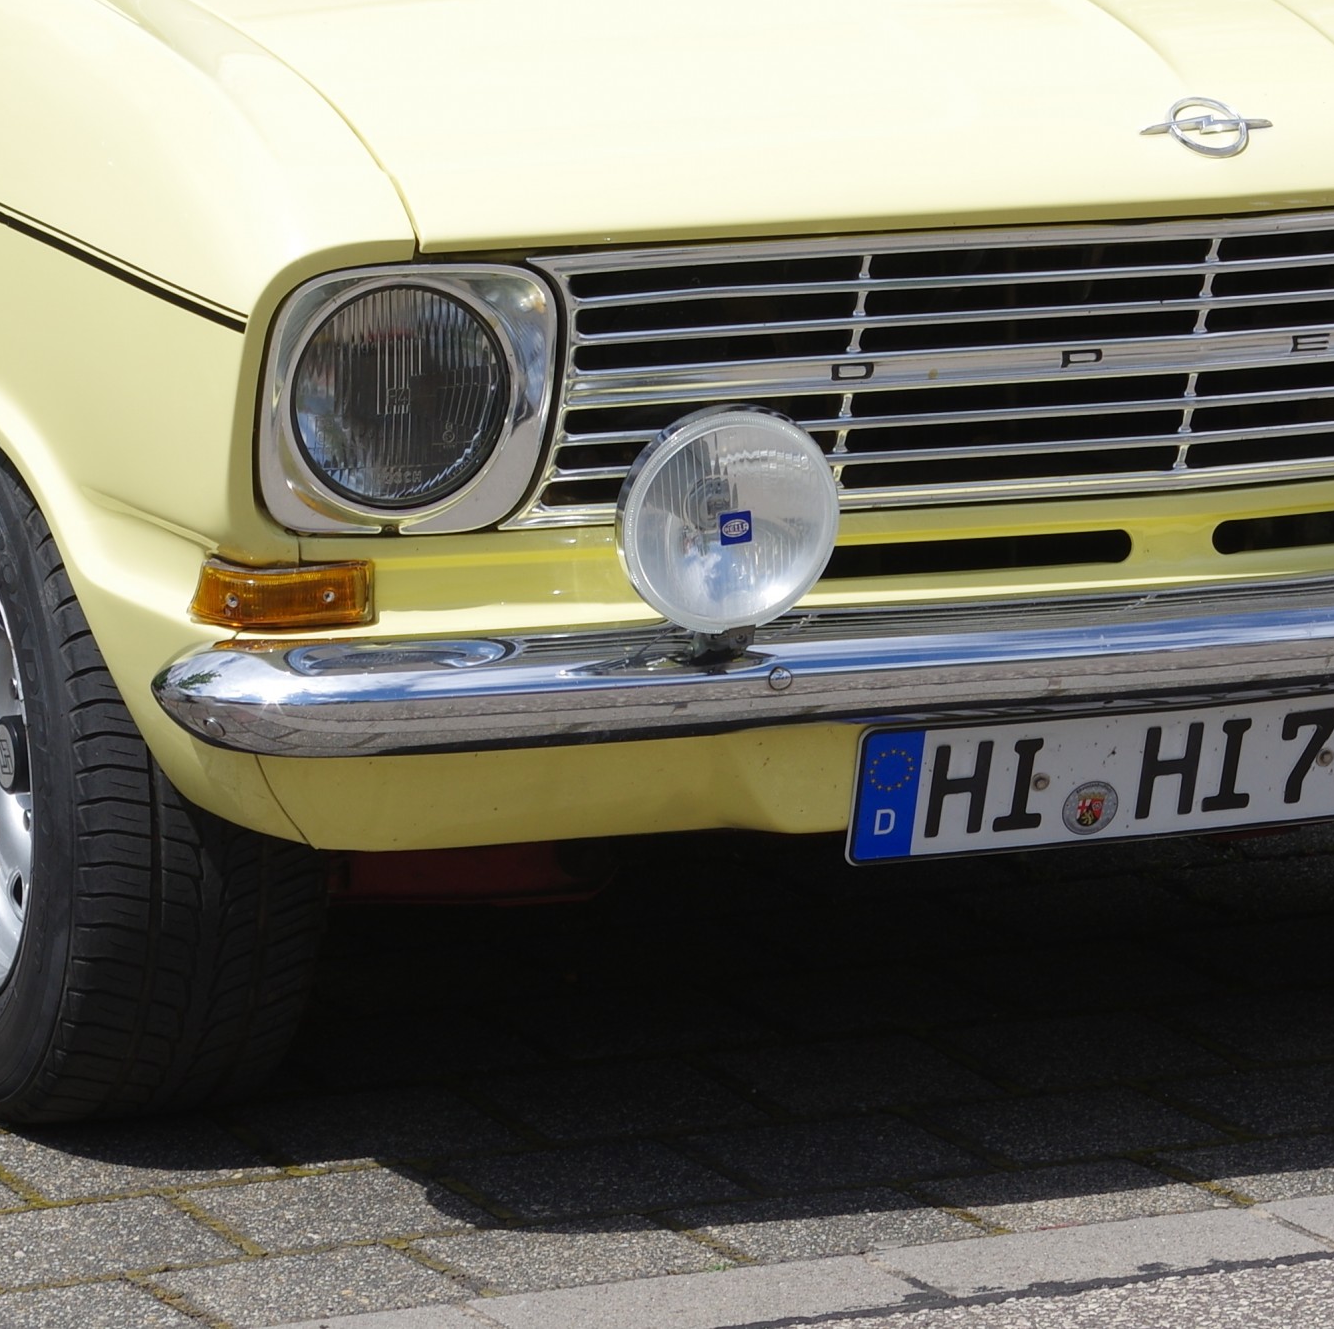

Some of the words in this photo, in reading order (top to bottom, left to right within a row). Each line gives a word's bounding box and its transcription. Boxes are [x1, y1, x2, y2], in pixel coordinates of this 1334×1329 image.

[874, 808, 895, 835] D
[924, 737, 1044, 838] HI
[1134, 717, 1253, 820] HI
